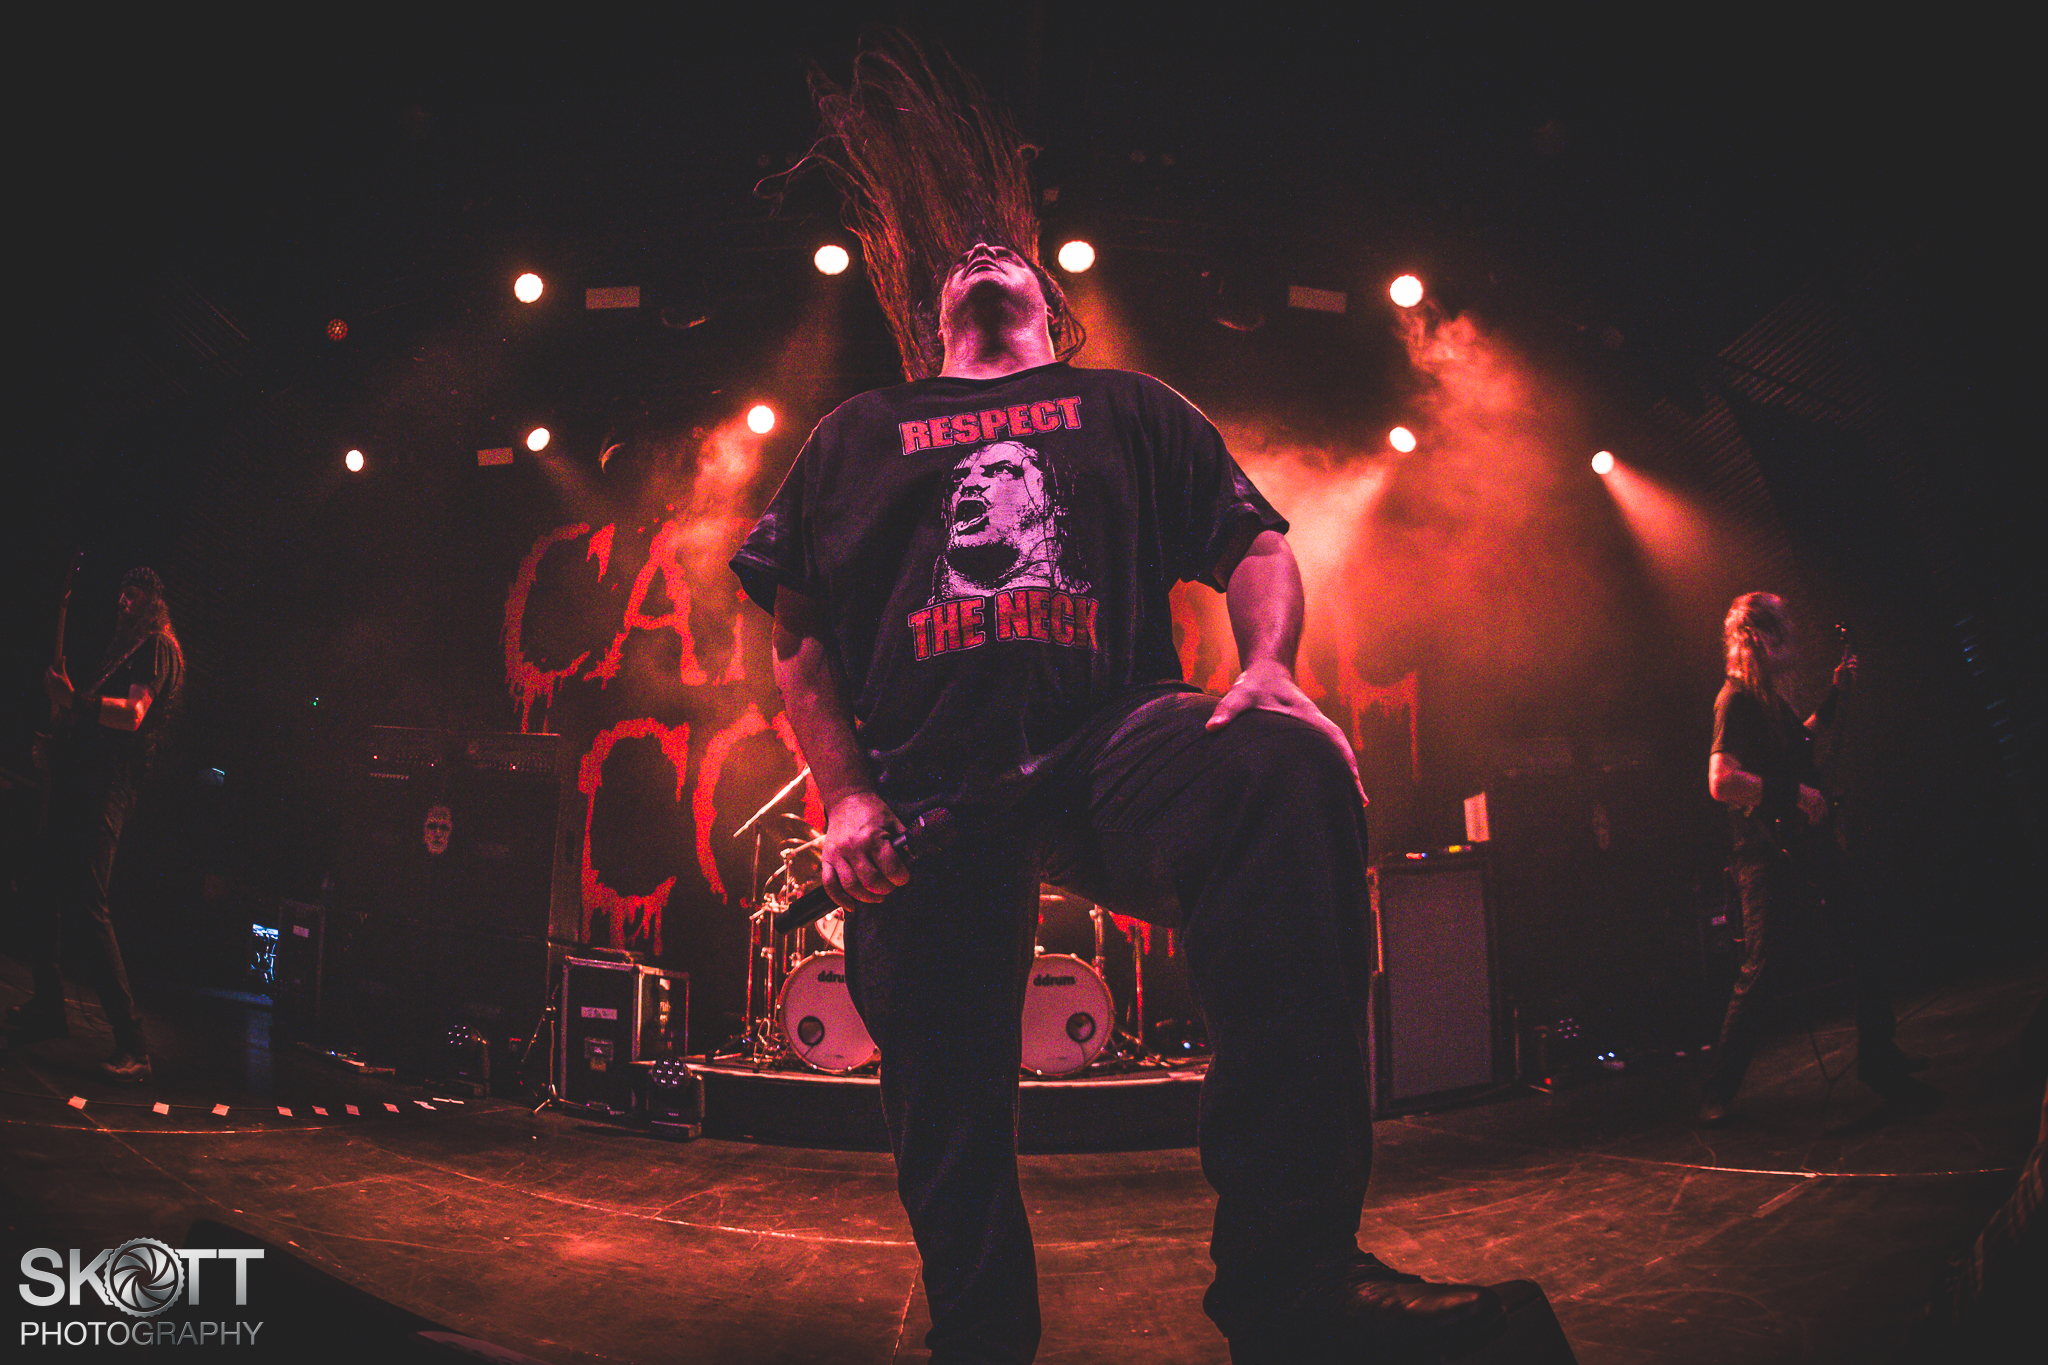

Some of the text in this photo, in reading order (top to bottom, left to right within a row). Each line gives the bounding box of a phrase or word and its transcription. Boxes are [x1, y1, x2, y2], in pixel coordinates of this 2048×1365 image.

[899, 396, 1082, 455] RESPECT
[908, 586, 1099, 661] THE NECK
[817, 970, 845, 983] ddru
[1033, 974, 1076, 986] ddrum
